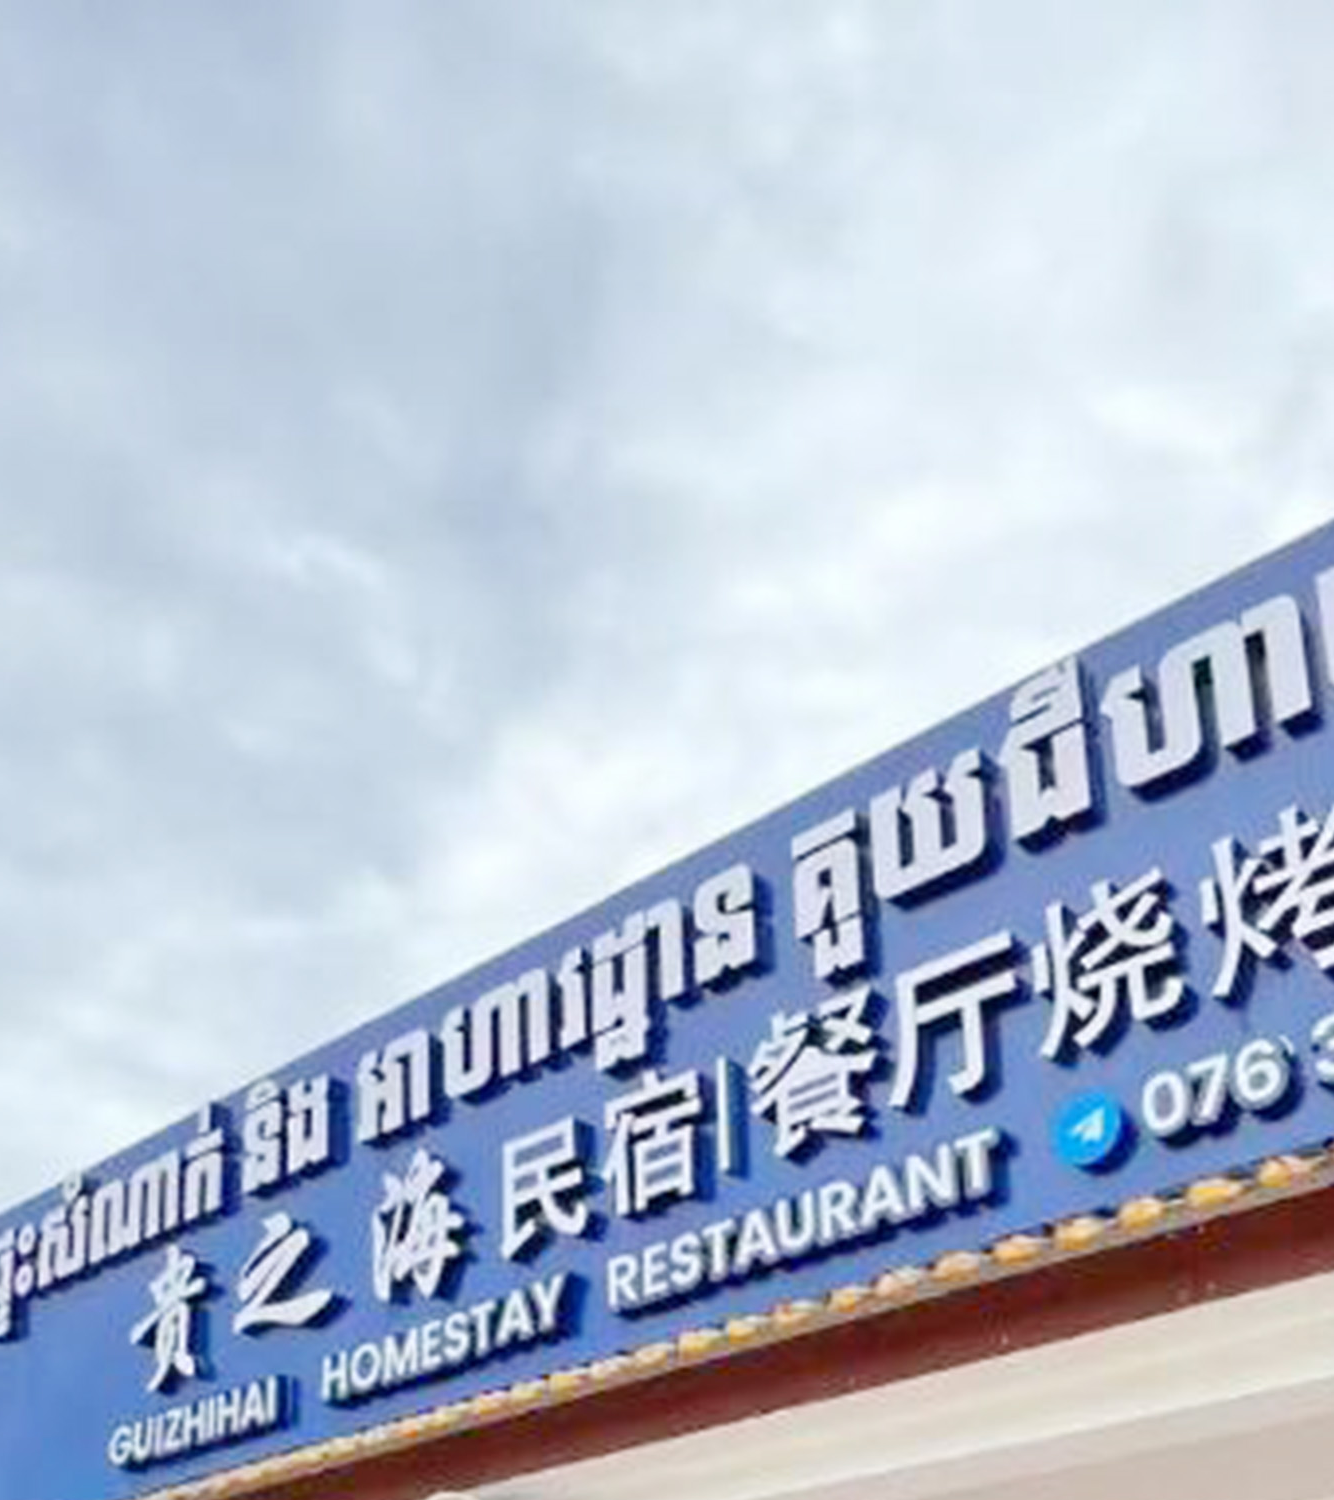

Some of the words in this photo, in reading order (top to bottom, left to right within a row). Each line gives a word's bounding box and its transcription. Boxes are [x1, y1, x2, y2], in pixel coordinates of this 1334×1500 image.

[241, 1072, 329, 1194] និង
[1141, 1037, 1289, 1138] 076
[106, 1374, 278, 1466] GUIZHIHAI
[321, 1273, 565, 1400] HOMESTAY
[606, 1126, 999, 1311] RESTAURANT
